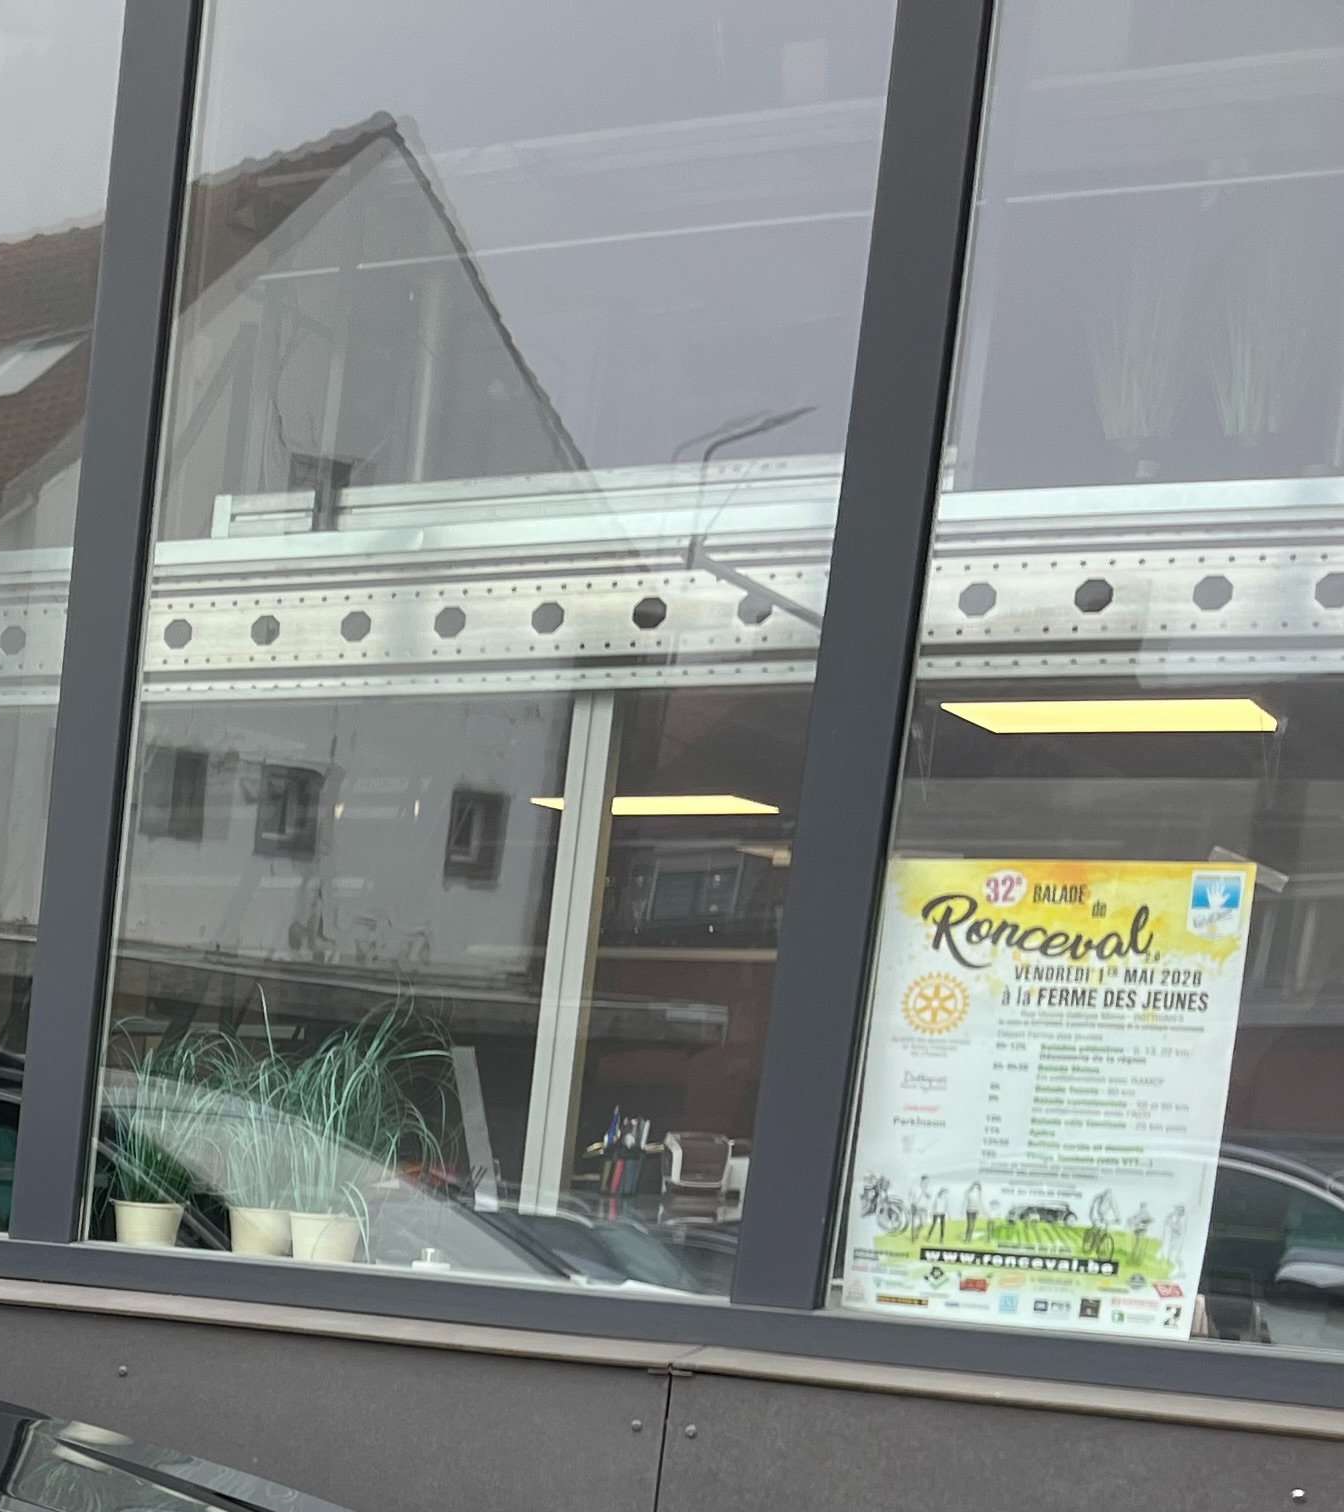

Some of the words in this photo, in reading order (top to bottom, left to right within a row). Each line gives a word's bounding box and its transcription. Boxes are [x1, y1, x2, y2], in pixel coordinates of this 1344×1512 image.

[1033, 882, 1087, 904] BALADE
[1091, 899, 1108, 918] de
[921, 891, 1154, 969] Ronceval
[1014, 965, 1090, 984] VENDREDI
[1123, 968, 1154, 986] MAI
[1001, 986, 1011, 1006] à
[1016, 987, 1031, 1007] la
[1037, 987, 1097, 1009] FERME
[1103, 989, 1137, 1010] DES
[1141, 990, 1210, 1013] JEUNES
[924, 1249, 1115, 1276] www.ronceval.be
